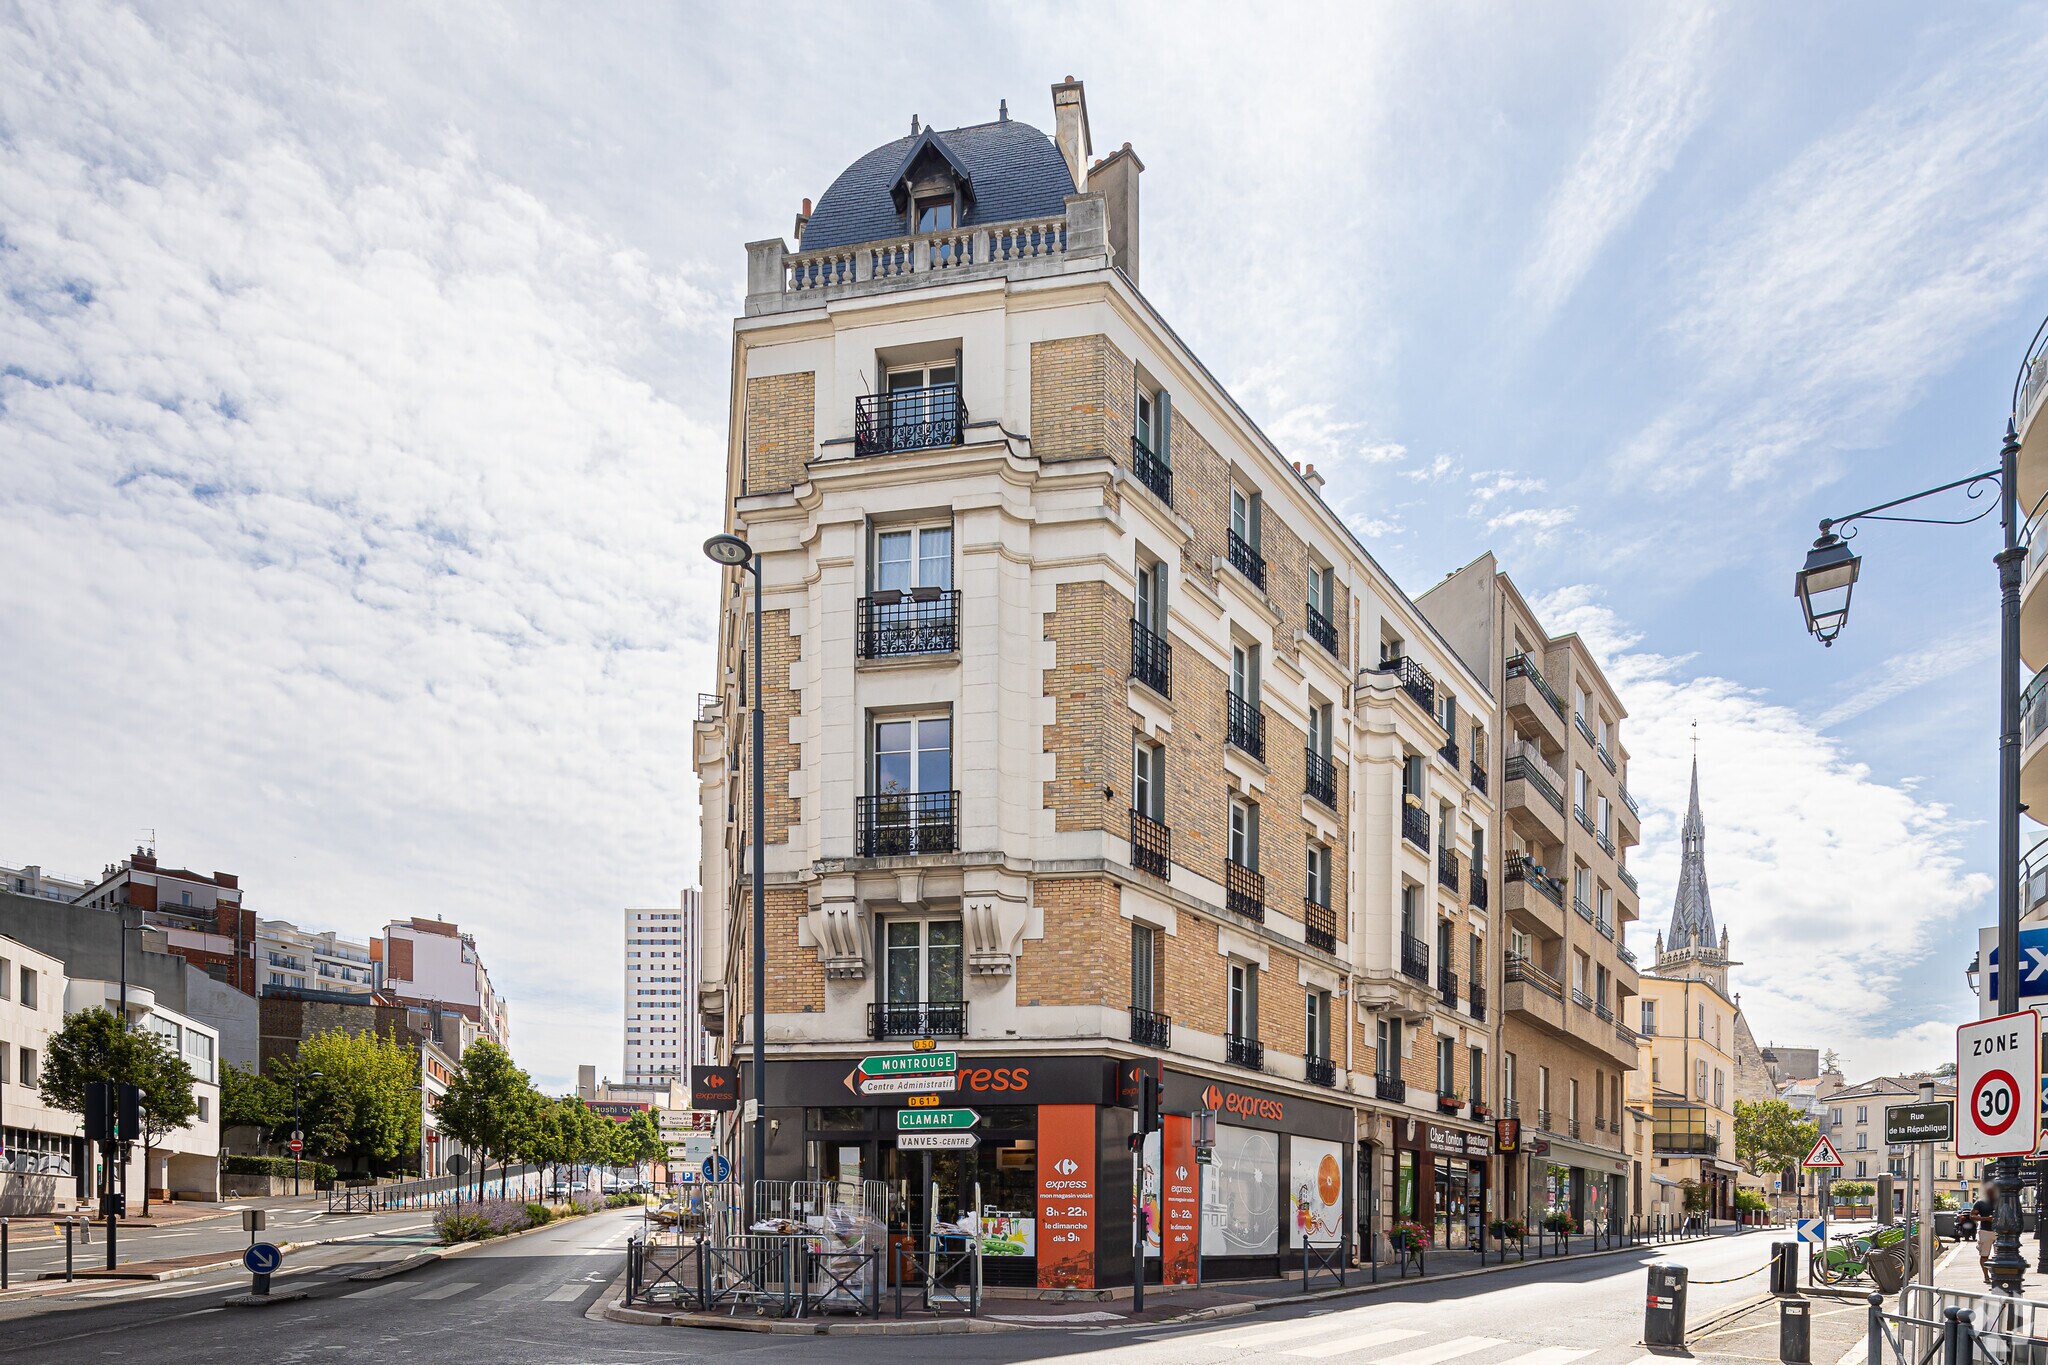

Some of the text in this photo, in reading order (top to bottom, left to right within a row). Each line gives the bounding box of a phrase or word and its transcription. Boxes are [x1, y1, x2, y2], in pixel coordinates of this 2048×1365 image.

[914, 1041, 920, 1049] D
[1973, 1032, 2018, 1056] ZONE
[882, 1056, 952, 1070] MONTROUGE
[867, 1079, 953, 1091] Centre Administratif
[695, 1092, 733, 1101] express
[911, 1097, 916, 1105] D
[1225, 1092, 1284, 1121] express
[1980, 1088, 2010, 1117] 30
[902, 1113, 954, 1125] CLAMART
[1888, 1124, 1947, 1135] de la République
[1430, 1127, 1463, 1146] Chez Tonton
[1045, 1180, 1087, 1190] express
[1171, 1185, 1192, 1194] express
[1046, 1206, 1059, 1216] 8h
[1067, 1206, 1088, 1216] 22h
[1171, 1209, 1179, 1218] 8h
[1067, 1232, 1080, 1242] 9h
